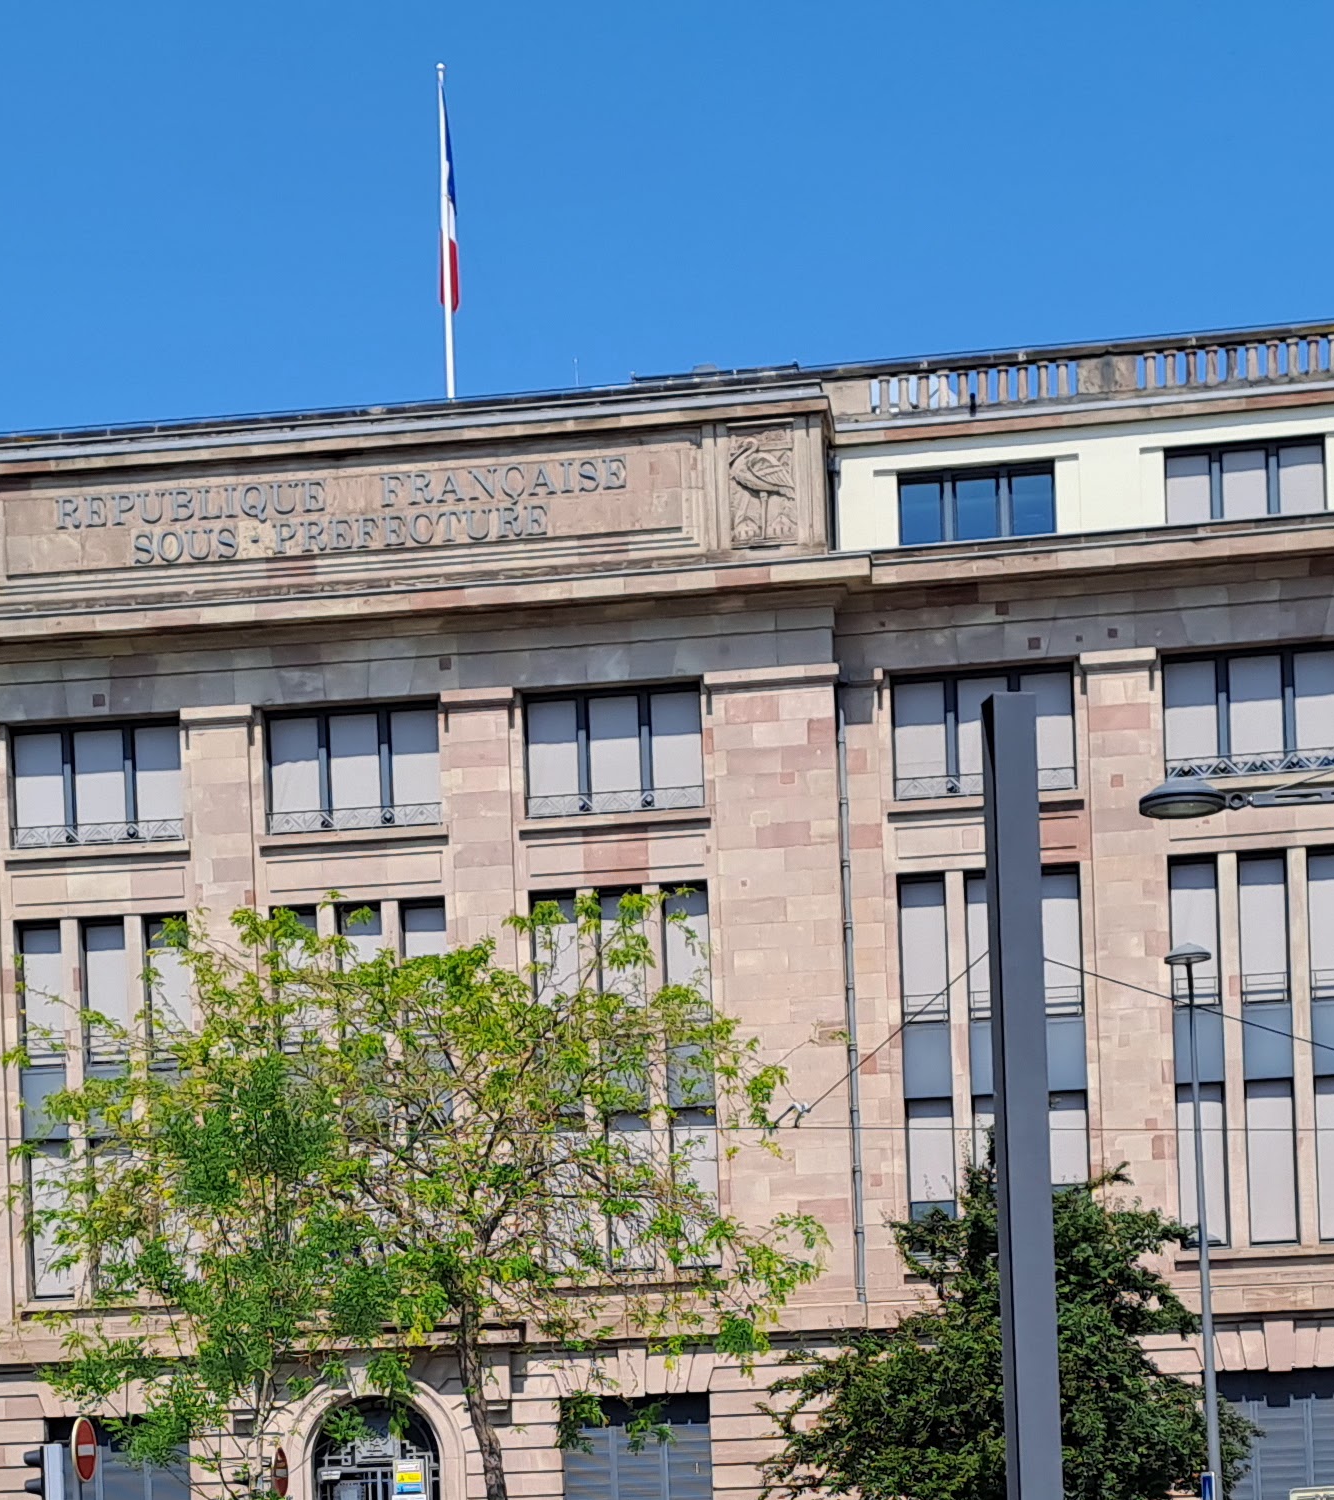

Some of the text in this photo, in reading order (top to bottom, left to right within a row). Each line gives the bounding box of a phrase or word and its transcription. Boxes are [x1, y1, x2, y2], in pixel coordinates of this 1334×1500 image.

[55, 455, 627, 530] REPUBLIQUE FRANÇAISE
[133, 527, 240, 565] SOUS
[272, 504, 548, 555] PREFECTURE
